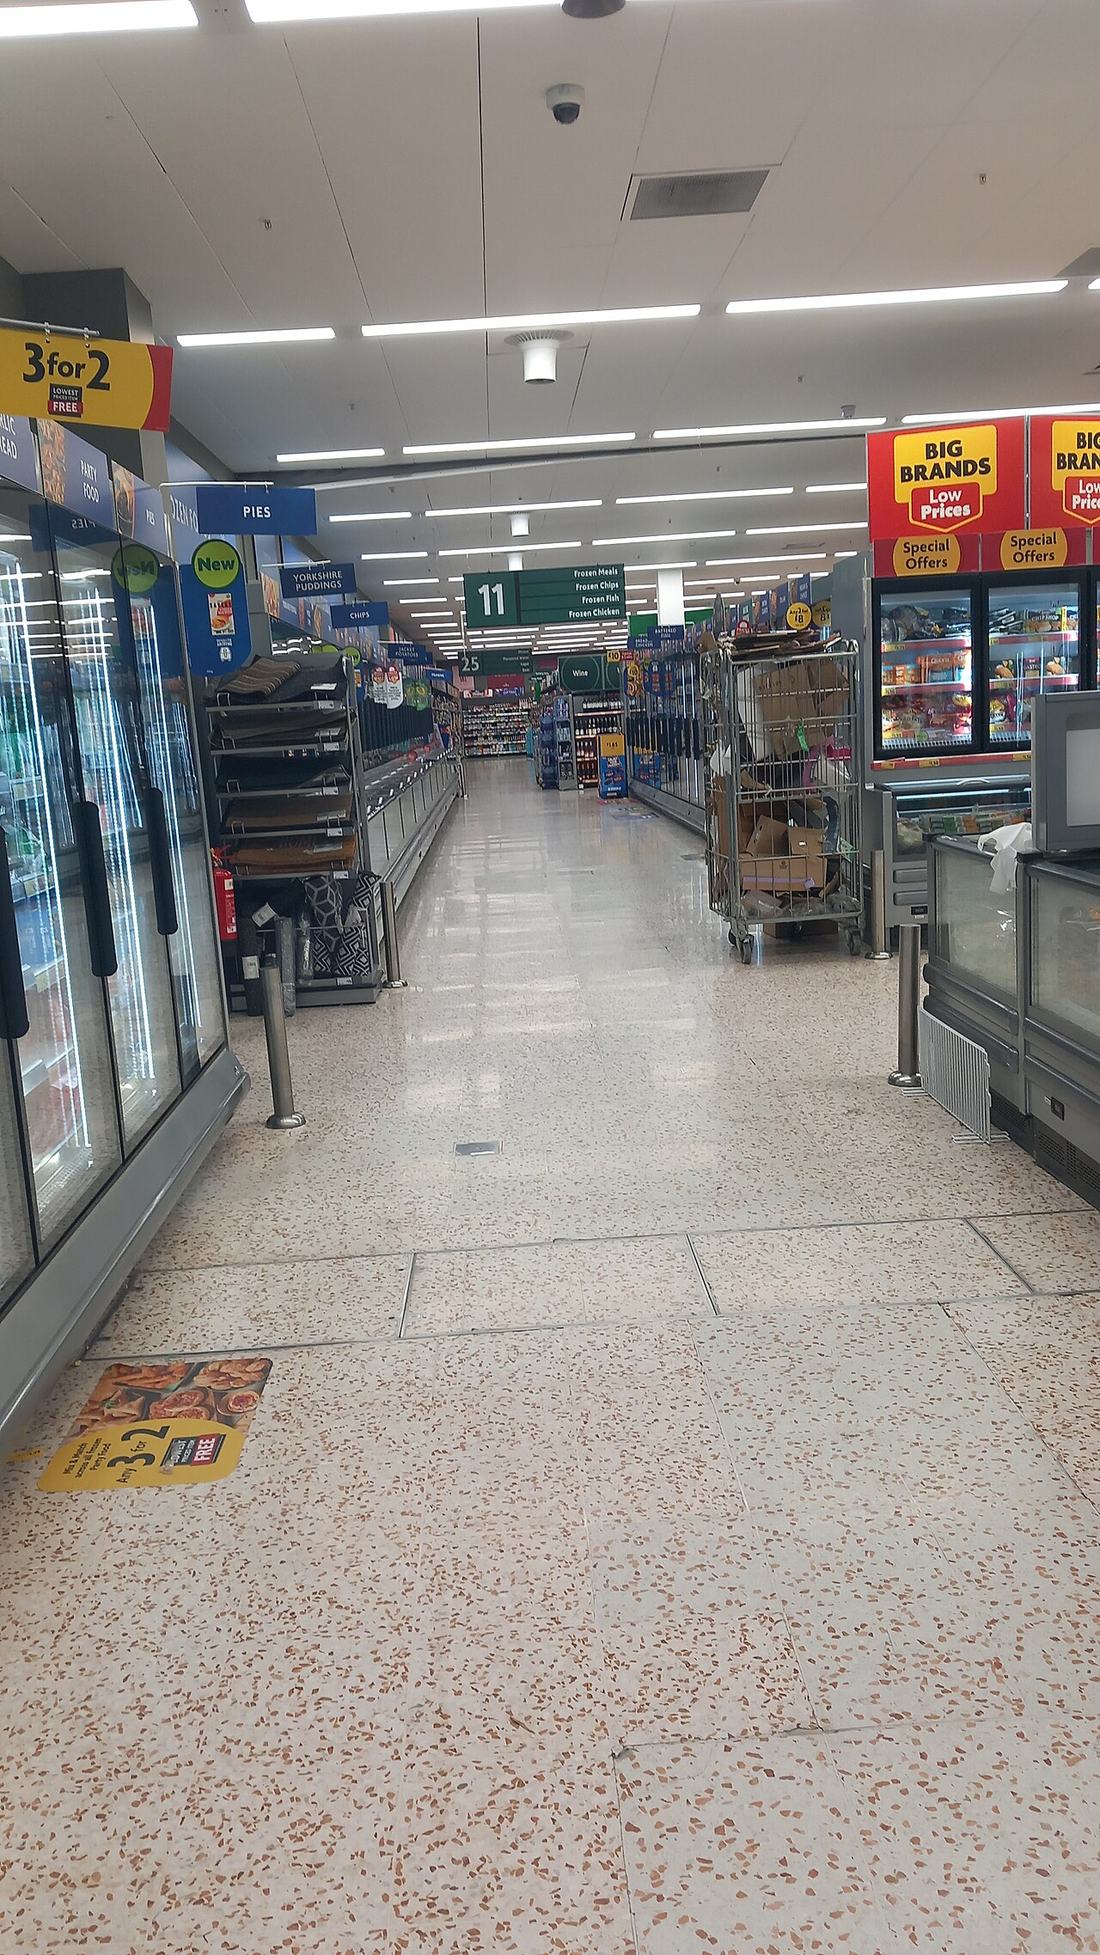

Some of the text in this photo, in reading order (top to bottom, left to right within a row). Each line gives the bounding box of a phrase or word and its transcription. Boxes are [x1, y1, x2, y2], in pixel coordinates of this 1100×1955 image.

[23, 342, 111, 391] 3 for 2
[53, 387, 79, 396] LOWEST
[53, 401, 79, 413] FREE
[925, 440, 963, 460] BIG
[80, 459, 97, 483] PARTY
[900, 457, 992, 483] BRANDS
[83, 482, 100, 503] FOOD
[930, 489, 962, 504] Low
[243, 505, 272, 522] PIES
[921, 503, 971, 520] Prices
[903, 540, 950, 556] Special
[1010, 535, 1057, 551] Special
[198, 557, 235, 573] New
[906, 556, 948, 570] Offers
[1013, 551, 1055, 565] Offers
[293, 571, 342, 583] YORKSHIRE
[574, 568, 619, 578] Frozen Meals
[295, 581, 342, 592] PUDDINGS
[575, 580, 620, 591] Frozen Chips
[478, 583, 505, 617] 11
[582, 594, 620, 605] Frozen Fish
[350, 610, 371, 620] CHIPS
[569, 606, 620, 619] Frozen Chicken
[461, 656, 480, 671] 25
[572, 669, 589, 679] Wine
[107, 1425, 171, 1483] Any 3 for 2
[193, 1438, 216, 1462] FREE
